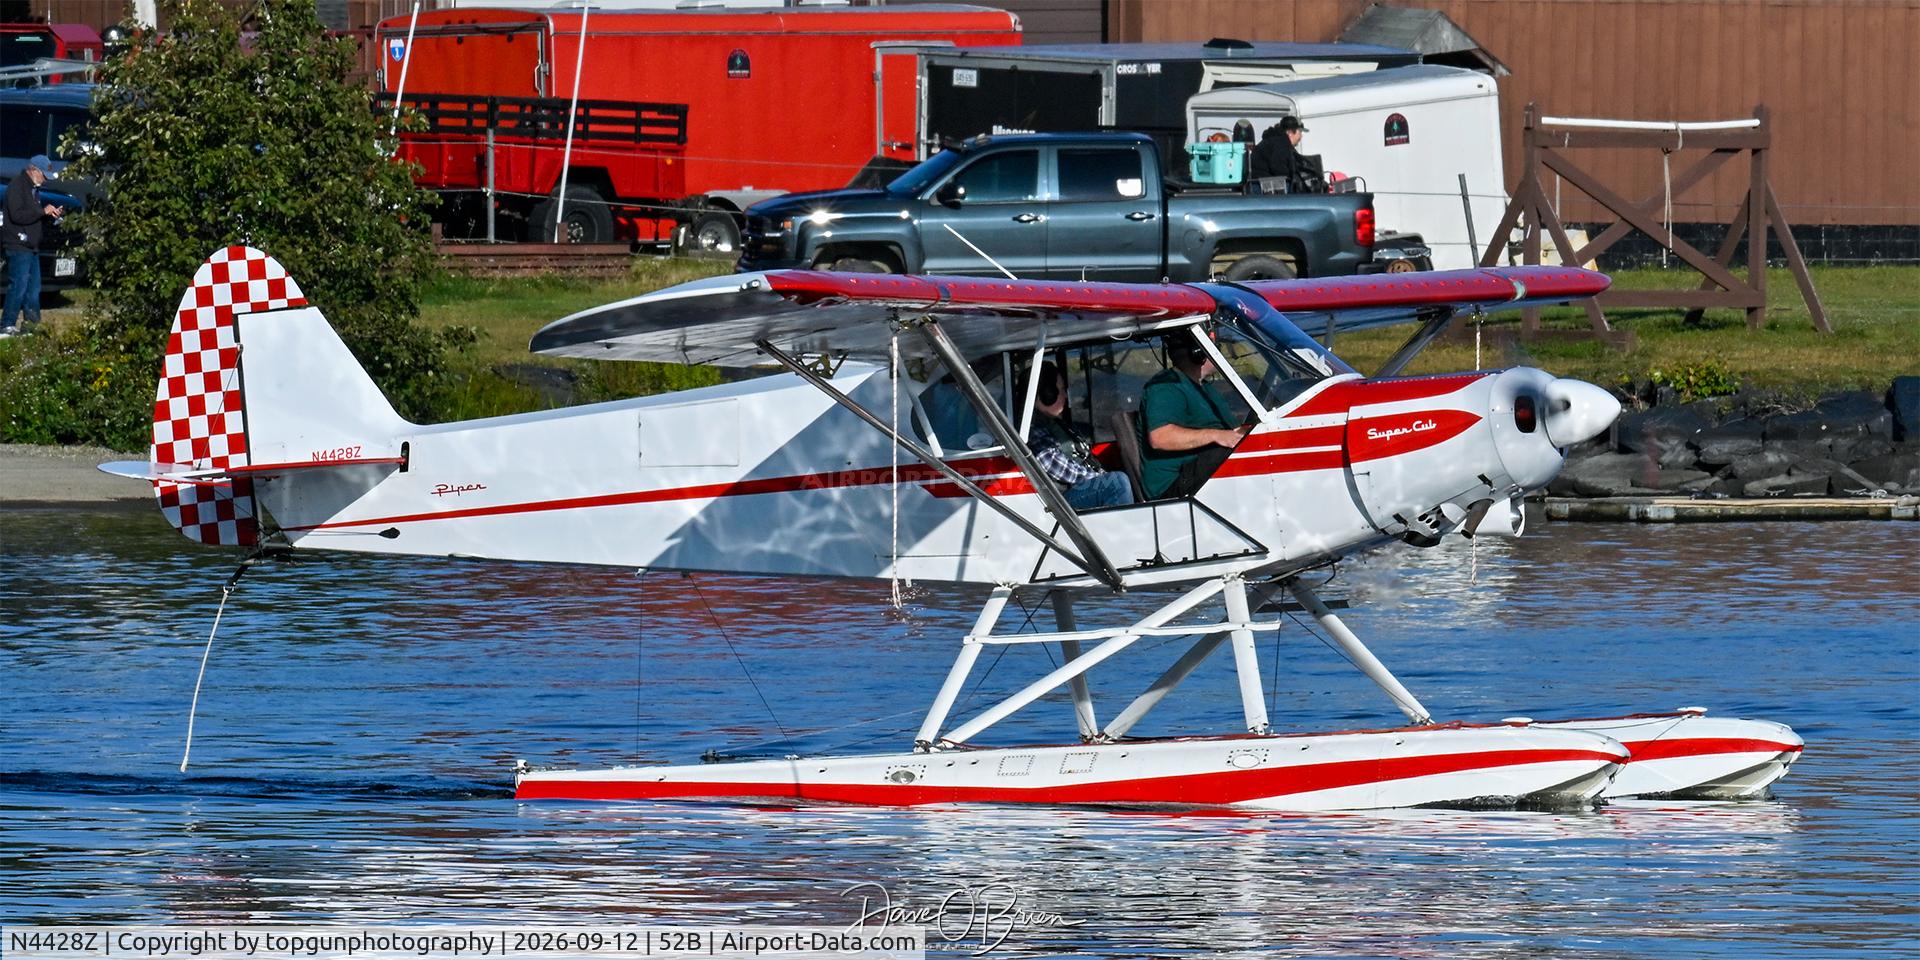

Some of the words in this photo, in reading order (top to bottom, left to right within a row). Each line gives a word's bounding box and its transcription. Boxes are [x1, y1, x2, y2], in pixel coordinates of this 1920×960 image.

[1367, 427, 1413, 441] Super
[1412, 419, 1437, 432] Cub
[312, 446, 361, 462] N4428Z
[430, 483, 487, 497] Piper
